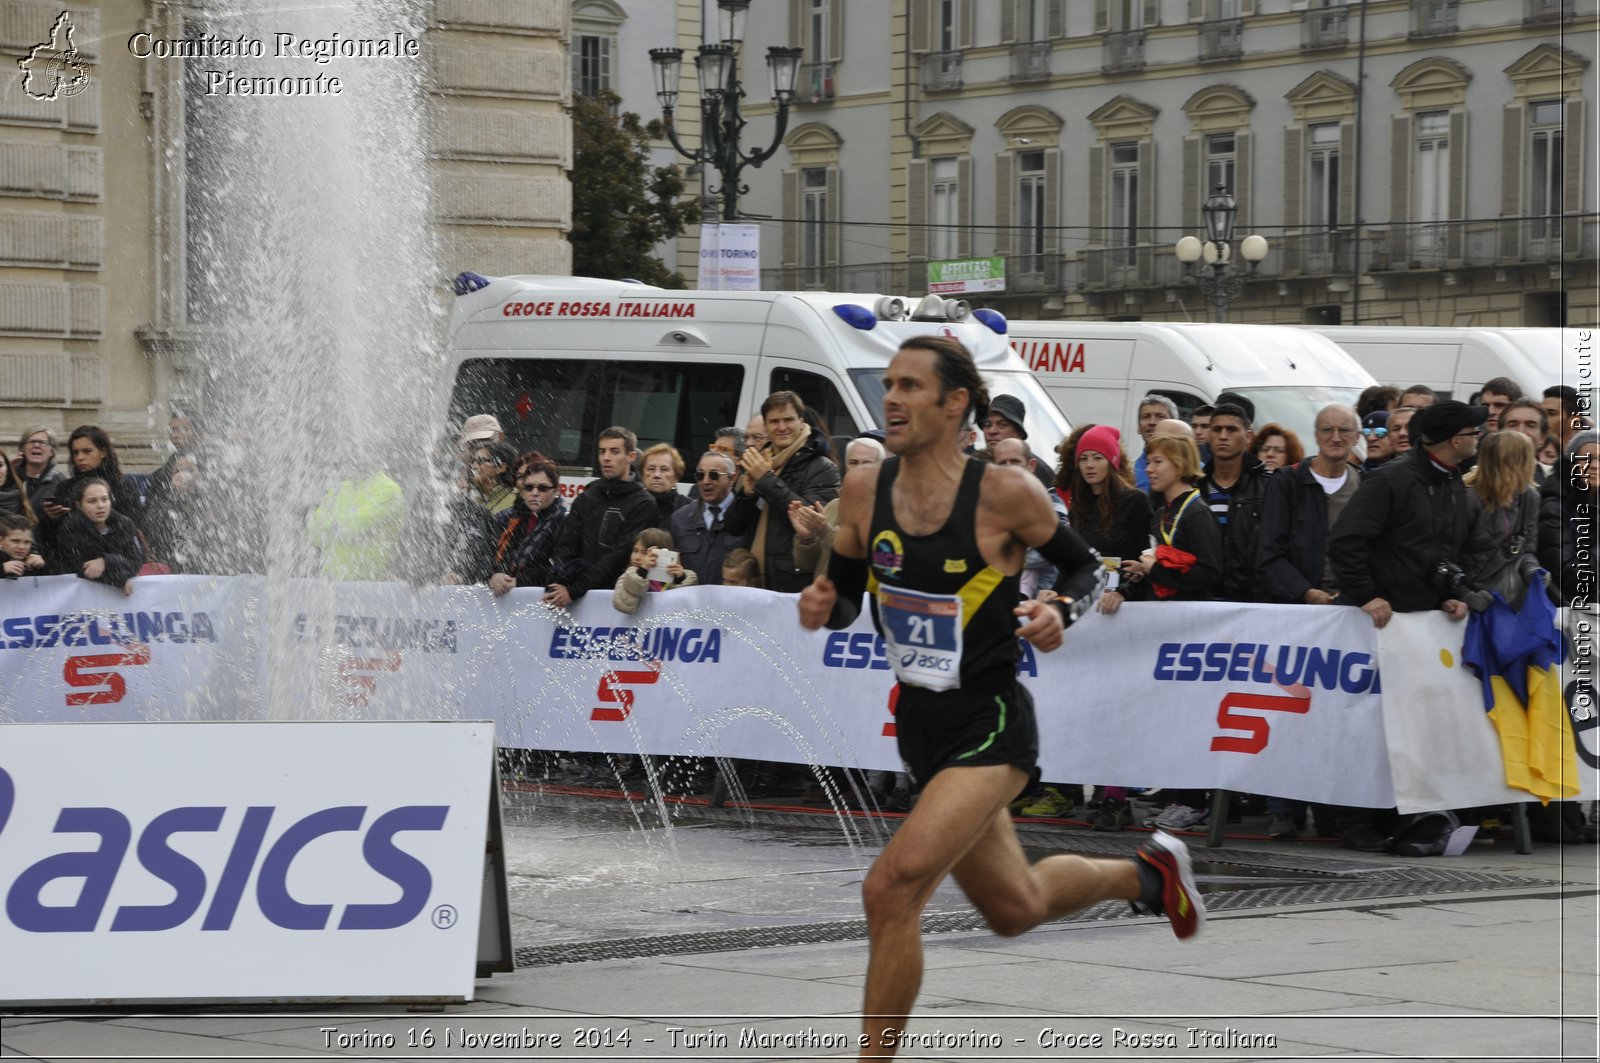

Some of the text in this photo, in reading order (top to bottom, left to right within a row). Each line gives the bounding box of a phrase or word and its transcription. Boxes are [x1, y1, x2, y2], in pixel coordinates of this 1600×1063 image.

[502, 302, 696, 318] CROCE ROSSA ITALIANA
[0, 611, 218, 650] SSELUNGA
[549, 626, 721, 664] ESSELUNGA
[907, 615, 936, 646] 21
[1153, 642, 1382, 695] ESSELUNG
